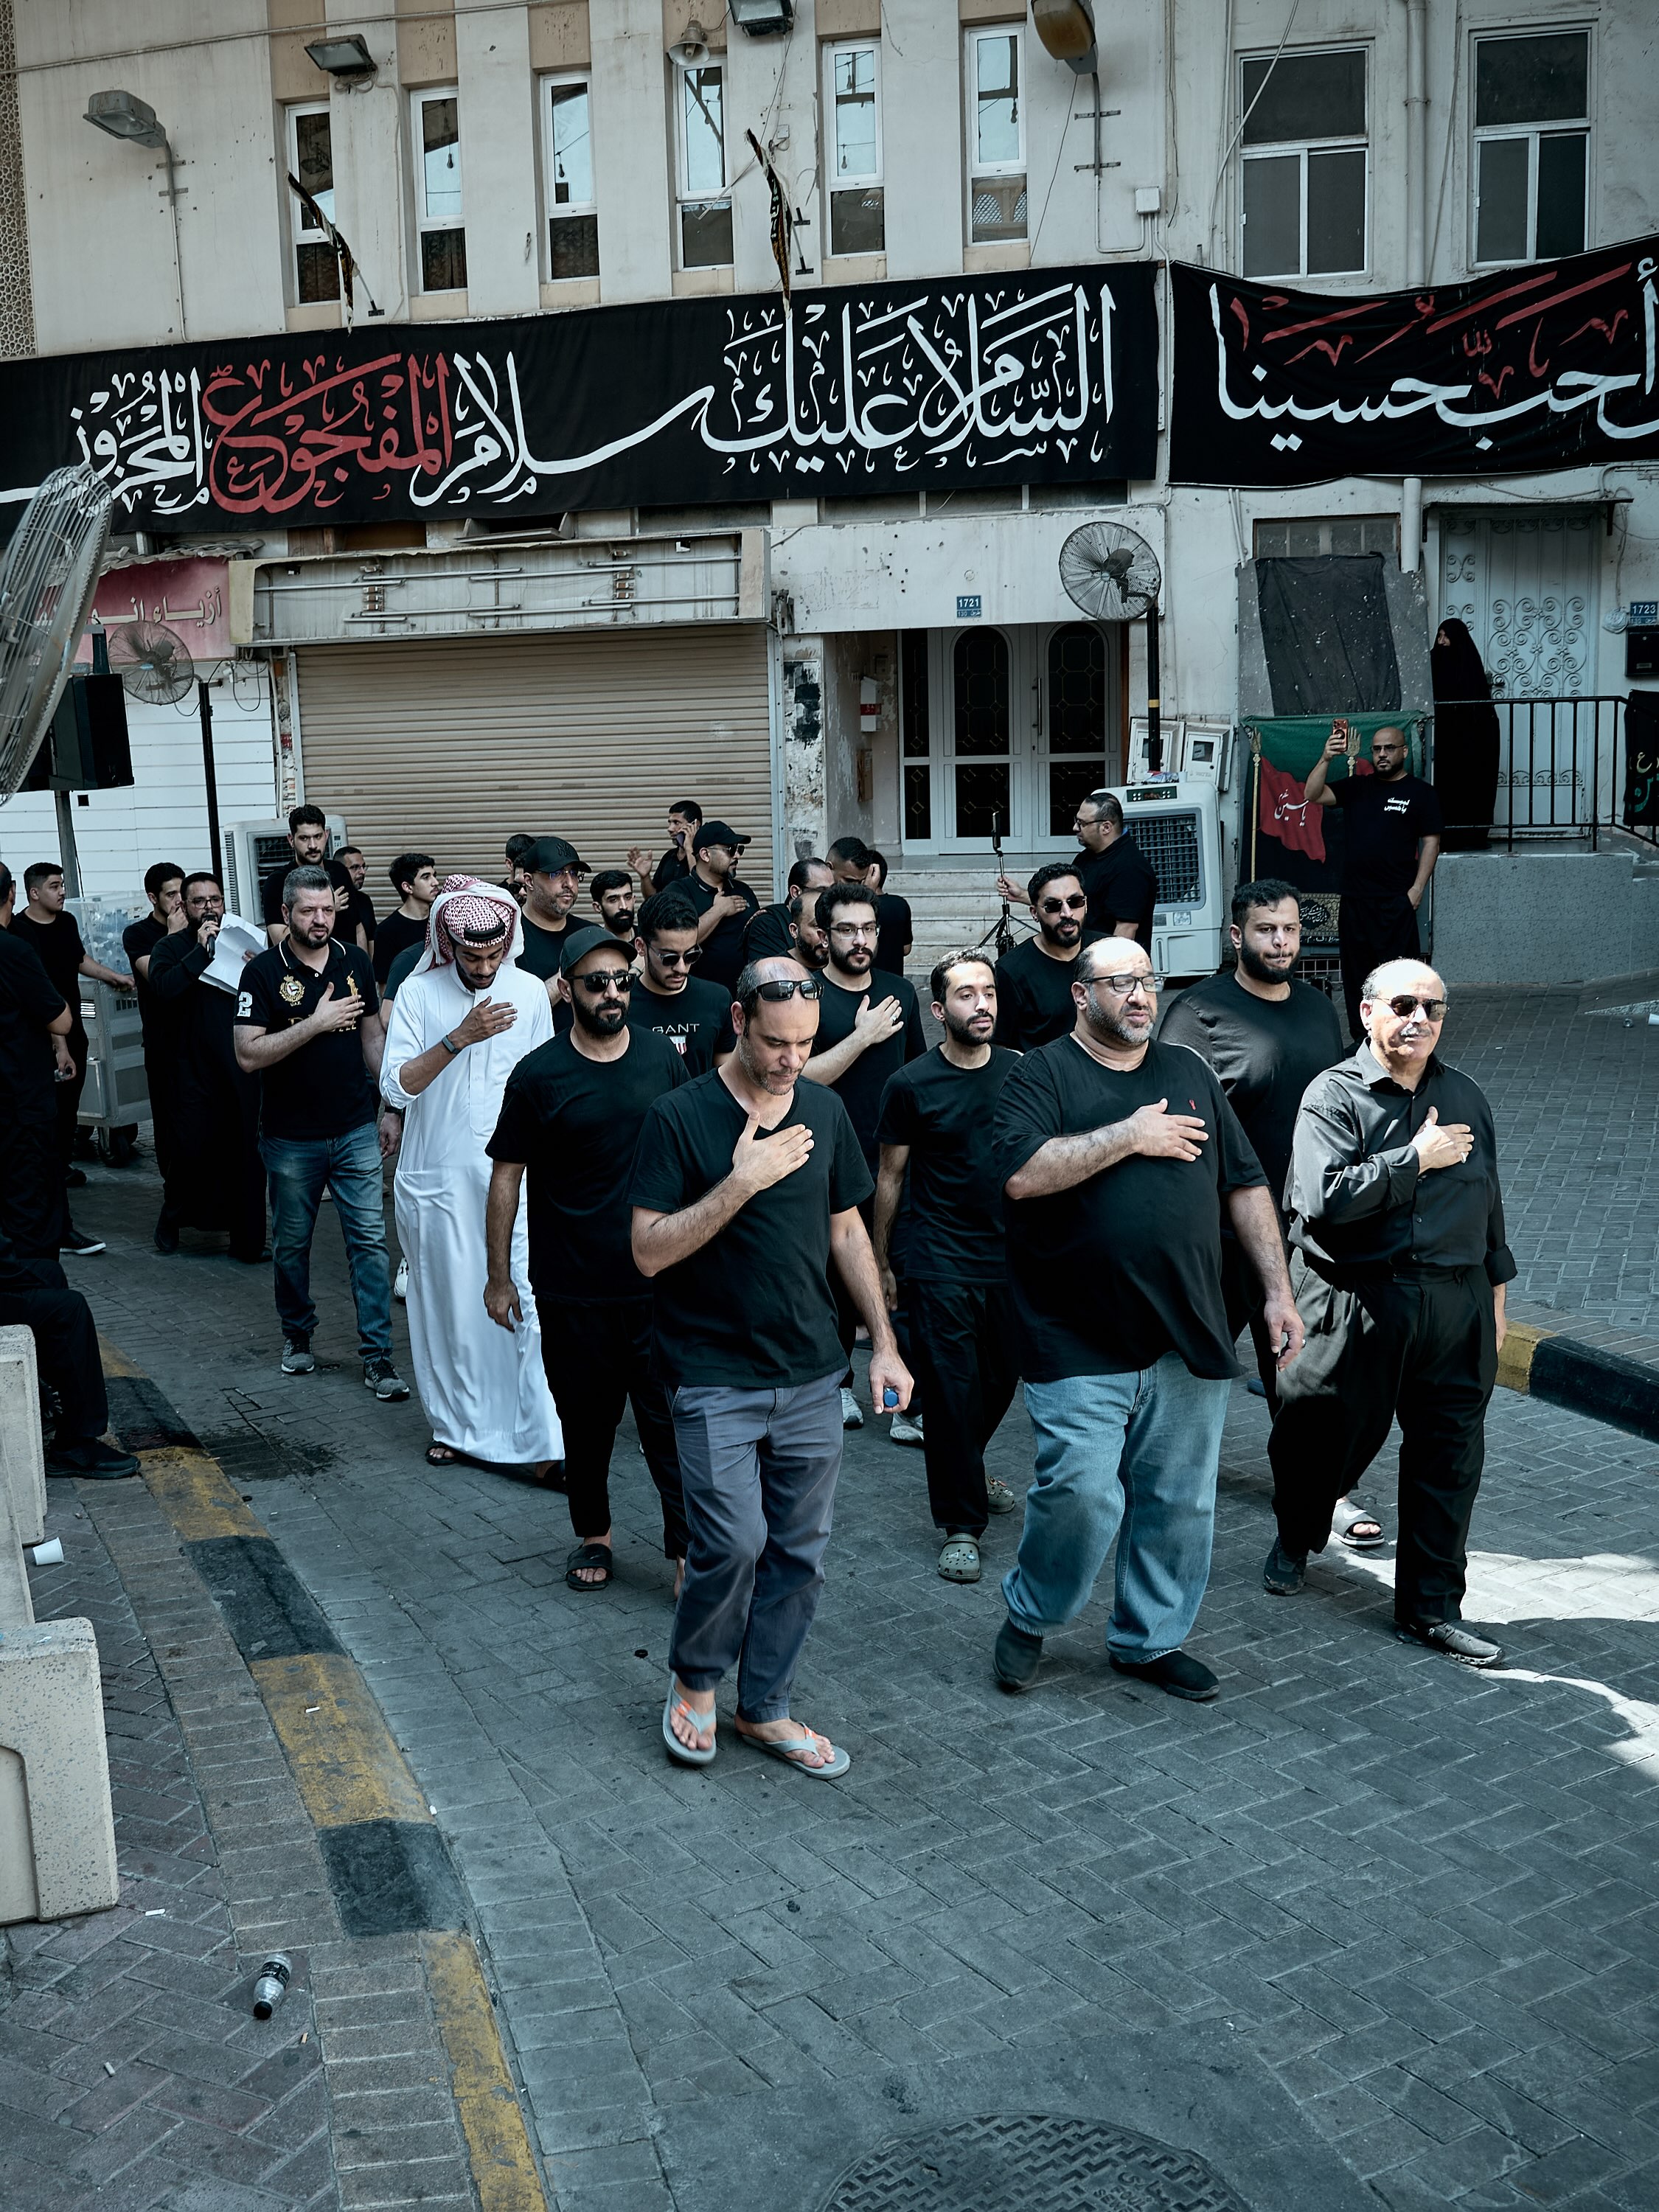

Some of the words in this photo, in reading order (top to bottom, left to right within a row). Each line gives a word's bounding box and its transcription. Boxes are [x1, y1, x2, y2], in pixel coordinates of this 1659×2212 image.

[959, 598, 978, 608] 1721
[1632, 604, 1656, 614] 1723
[237, 991, 253, 1018] 2
[652, 1023, 700, 1034] GANT
